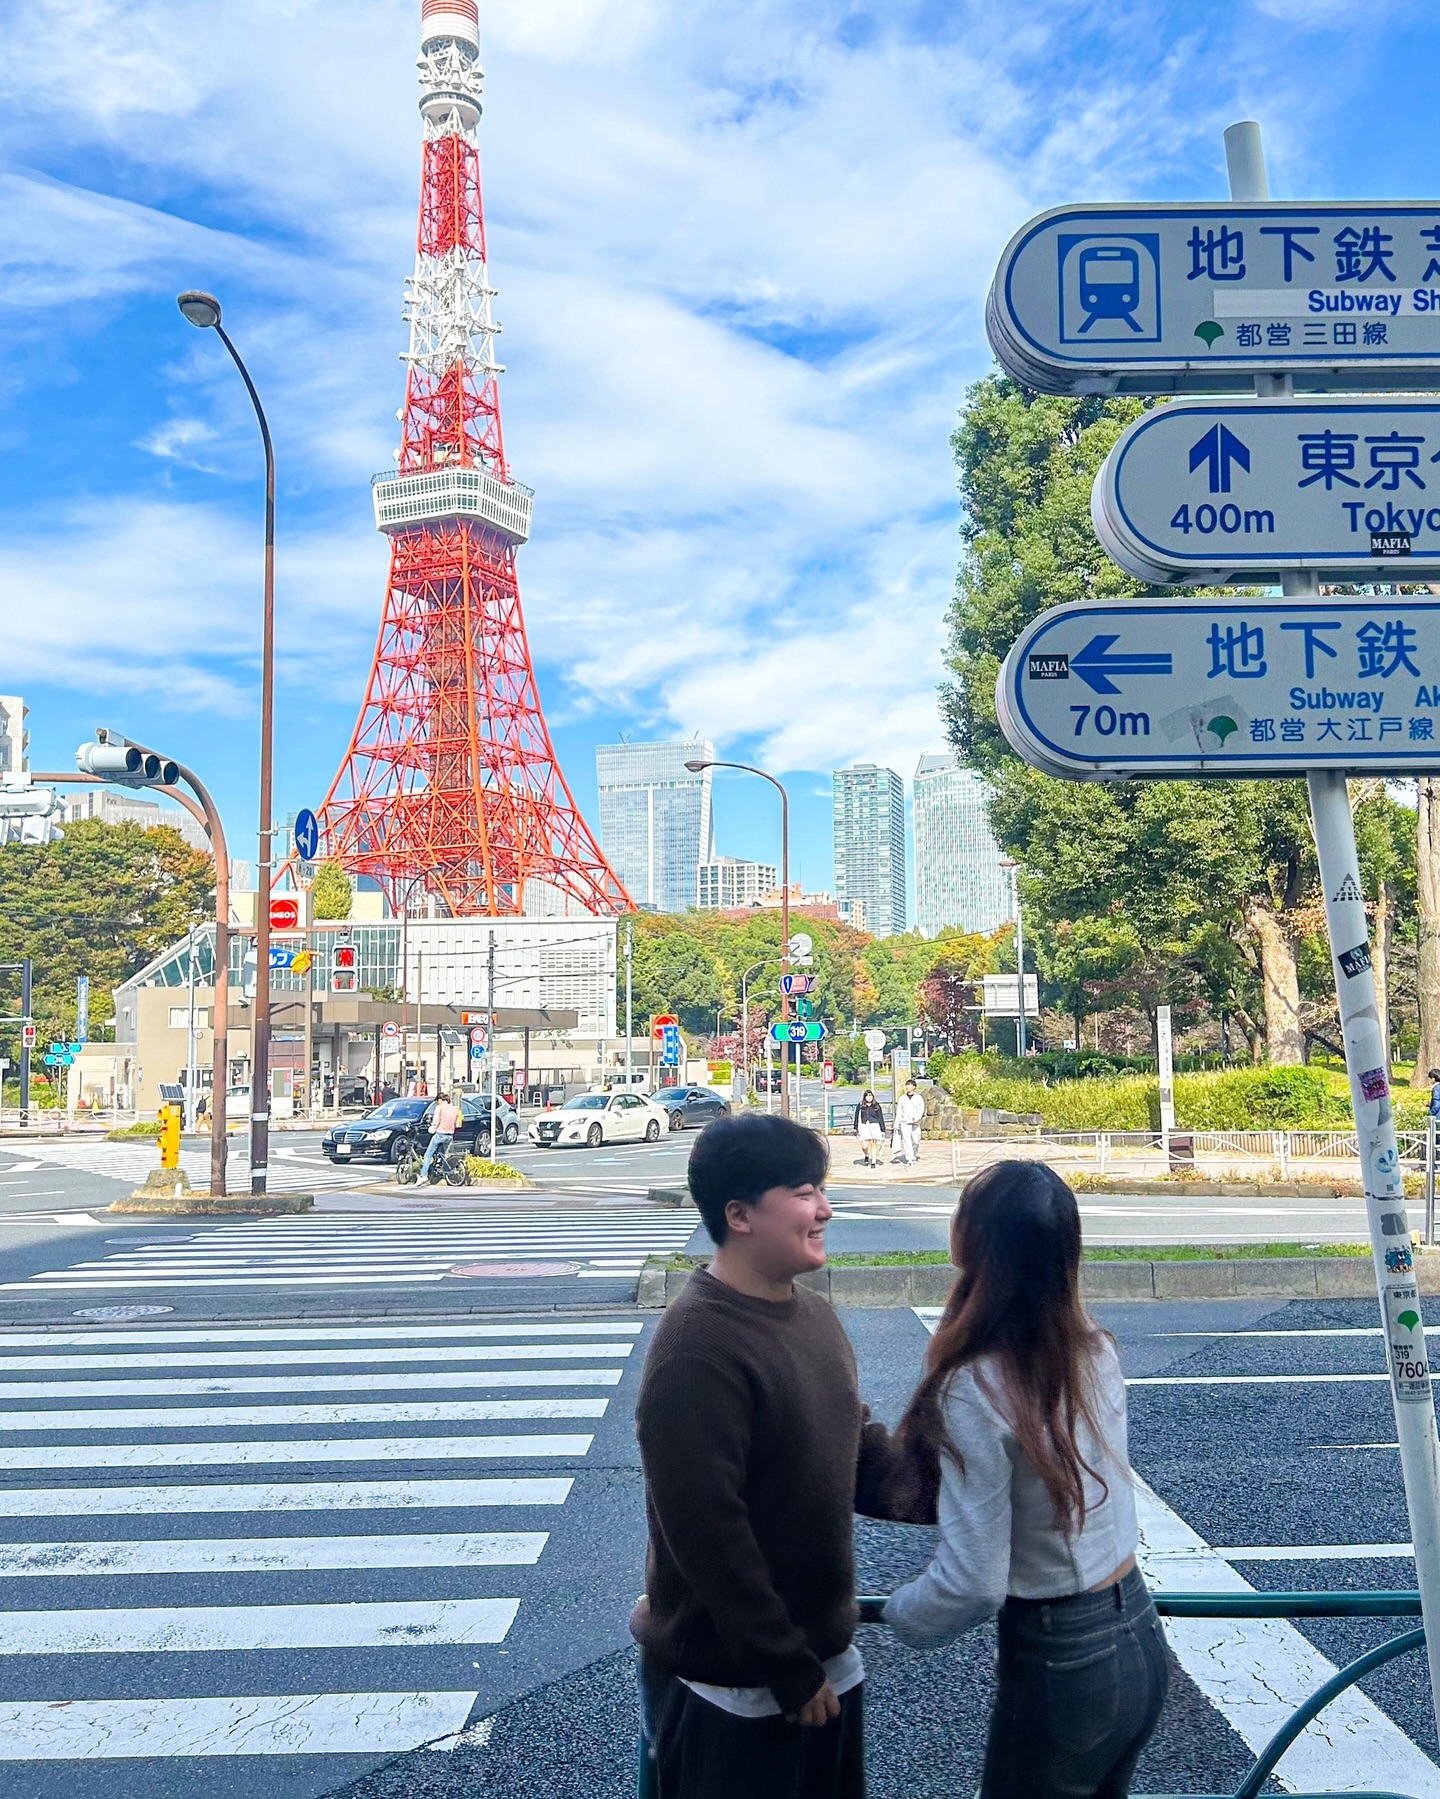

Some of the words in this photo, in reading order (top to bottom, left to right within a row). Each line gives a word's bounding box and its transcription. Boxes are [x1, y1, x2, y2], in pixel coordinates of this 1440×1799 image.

[1186, 225, 1397, 283] 地下鉄
[1308, 289, 1402, 316] Subway
[1236, 322, 1291, 347] 都営
[1303, 321, 1388, 346] 三田線
[1298, 429, 1440, 490] 東京
[1170, 503, 1275, 534] 400m
[1371, 538, 1410, 549] MAFIA
[1205, 620, 1421, 679] 地下鉄
[1030, 661, 1068, 672] MAFIA
[1289, 687, 1385, 713] Subway
[1069, 705, 1151, 736] 70m
[1249, 717, 1306, 742] 都営
[1317, 717, 1435, 742] 大江戸線
[1345, 954, 1371, 974] MAFI
[468, 1013, 489, 1024] ENEO
[790, 1026, 806, 1037] 319
[1395, 1350, 1410, 1359] 319
